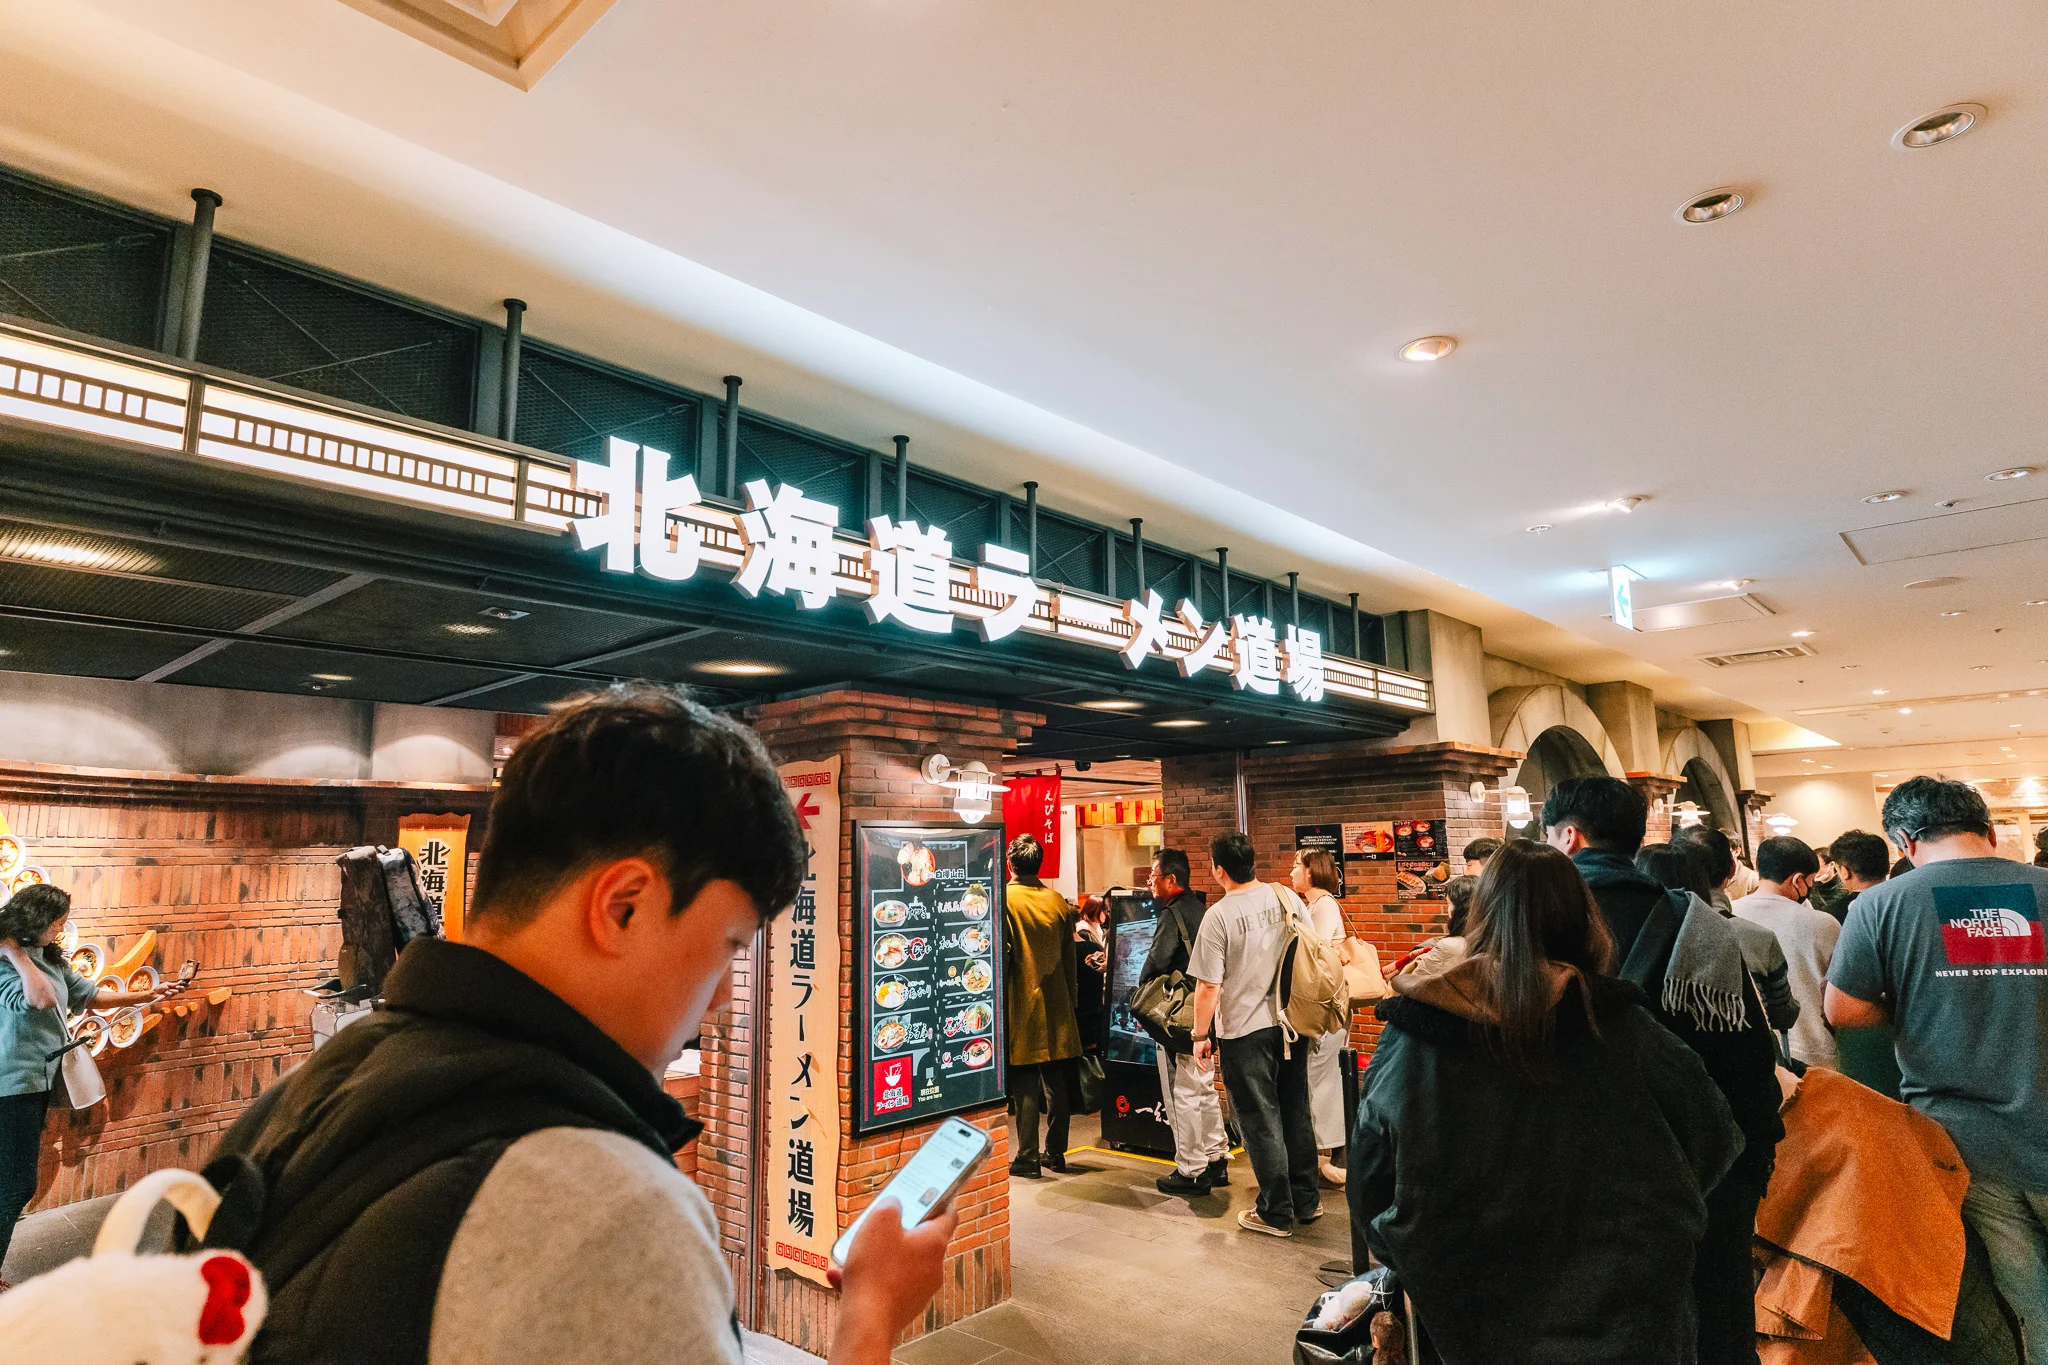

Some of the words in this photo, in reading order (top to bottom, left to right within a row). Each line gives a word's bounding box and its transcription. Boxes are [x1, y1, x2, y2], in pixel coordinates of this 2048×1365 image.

[565, 434, 1326, 702] 北海道ラーメン道場
[1043, 789, 1054, 844] えびそば
[1969, 908, 1998, 918] THE
[1949, 918, 2001, 929] NORTH
[1966, 927, 2003, 938] FACE
[1935, 969, 1969, 977] NEVER
[1972, 968, 1999, 976] STOP
[883, 1087, 903, 1100] 北海道
[876, 1095, 909, 1111] ラーメン道場
